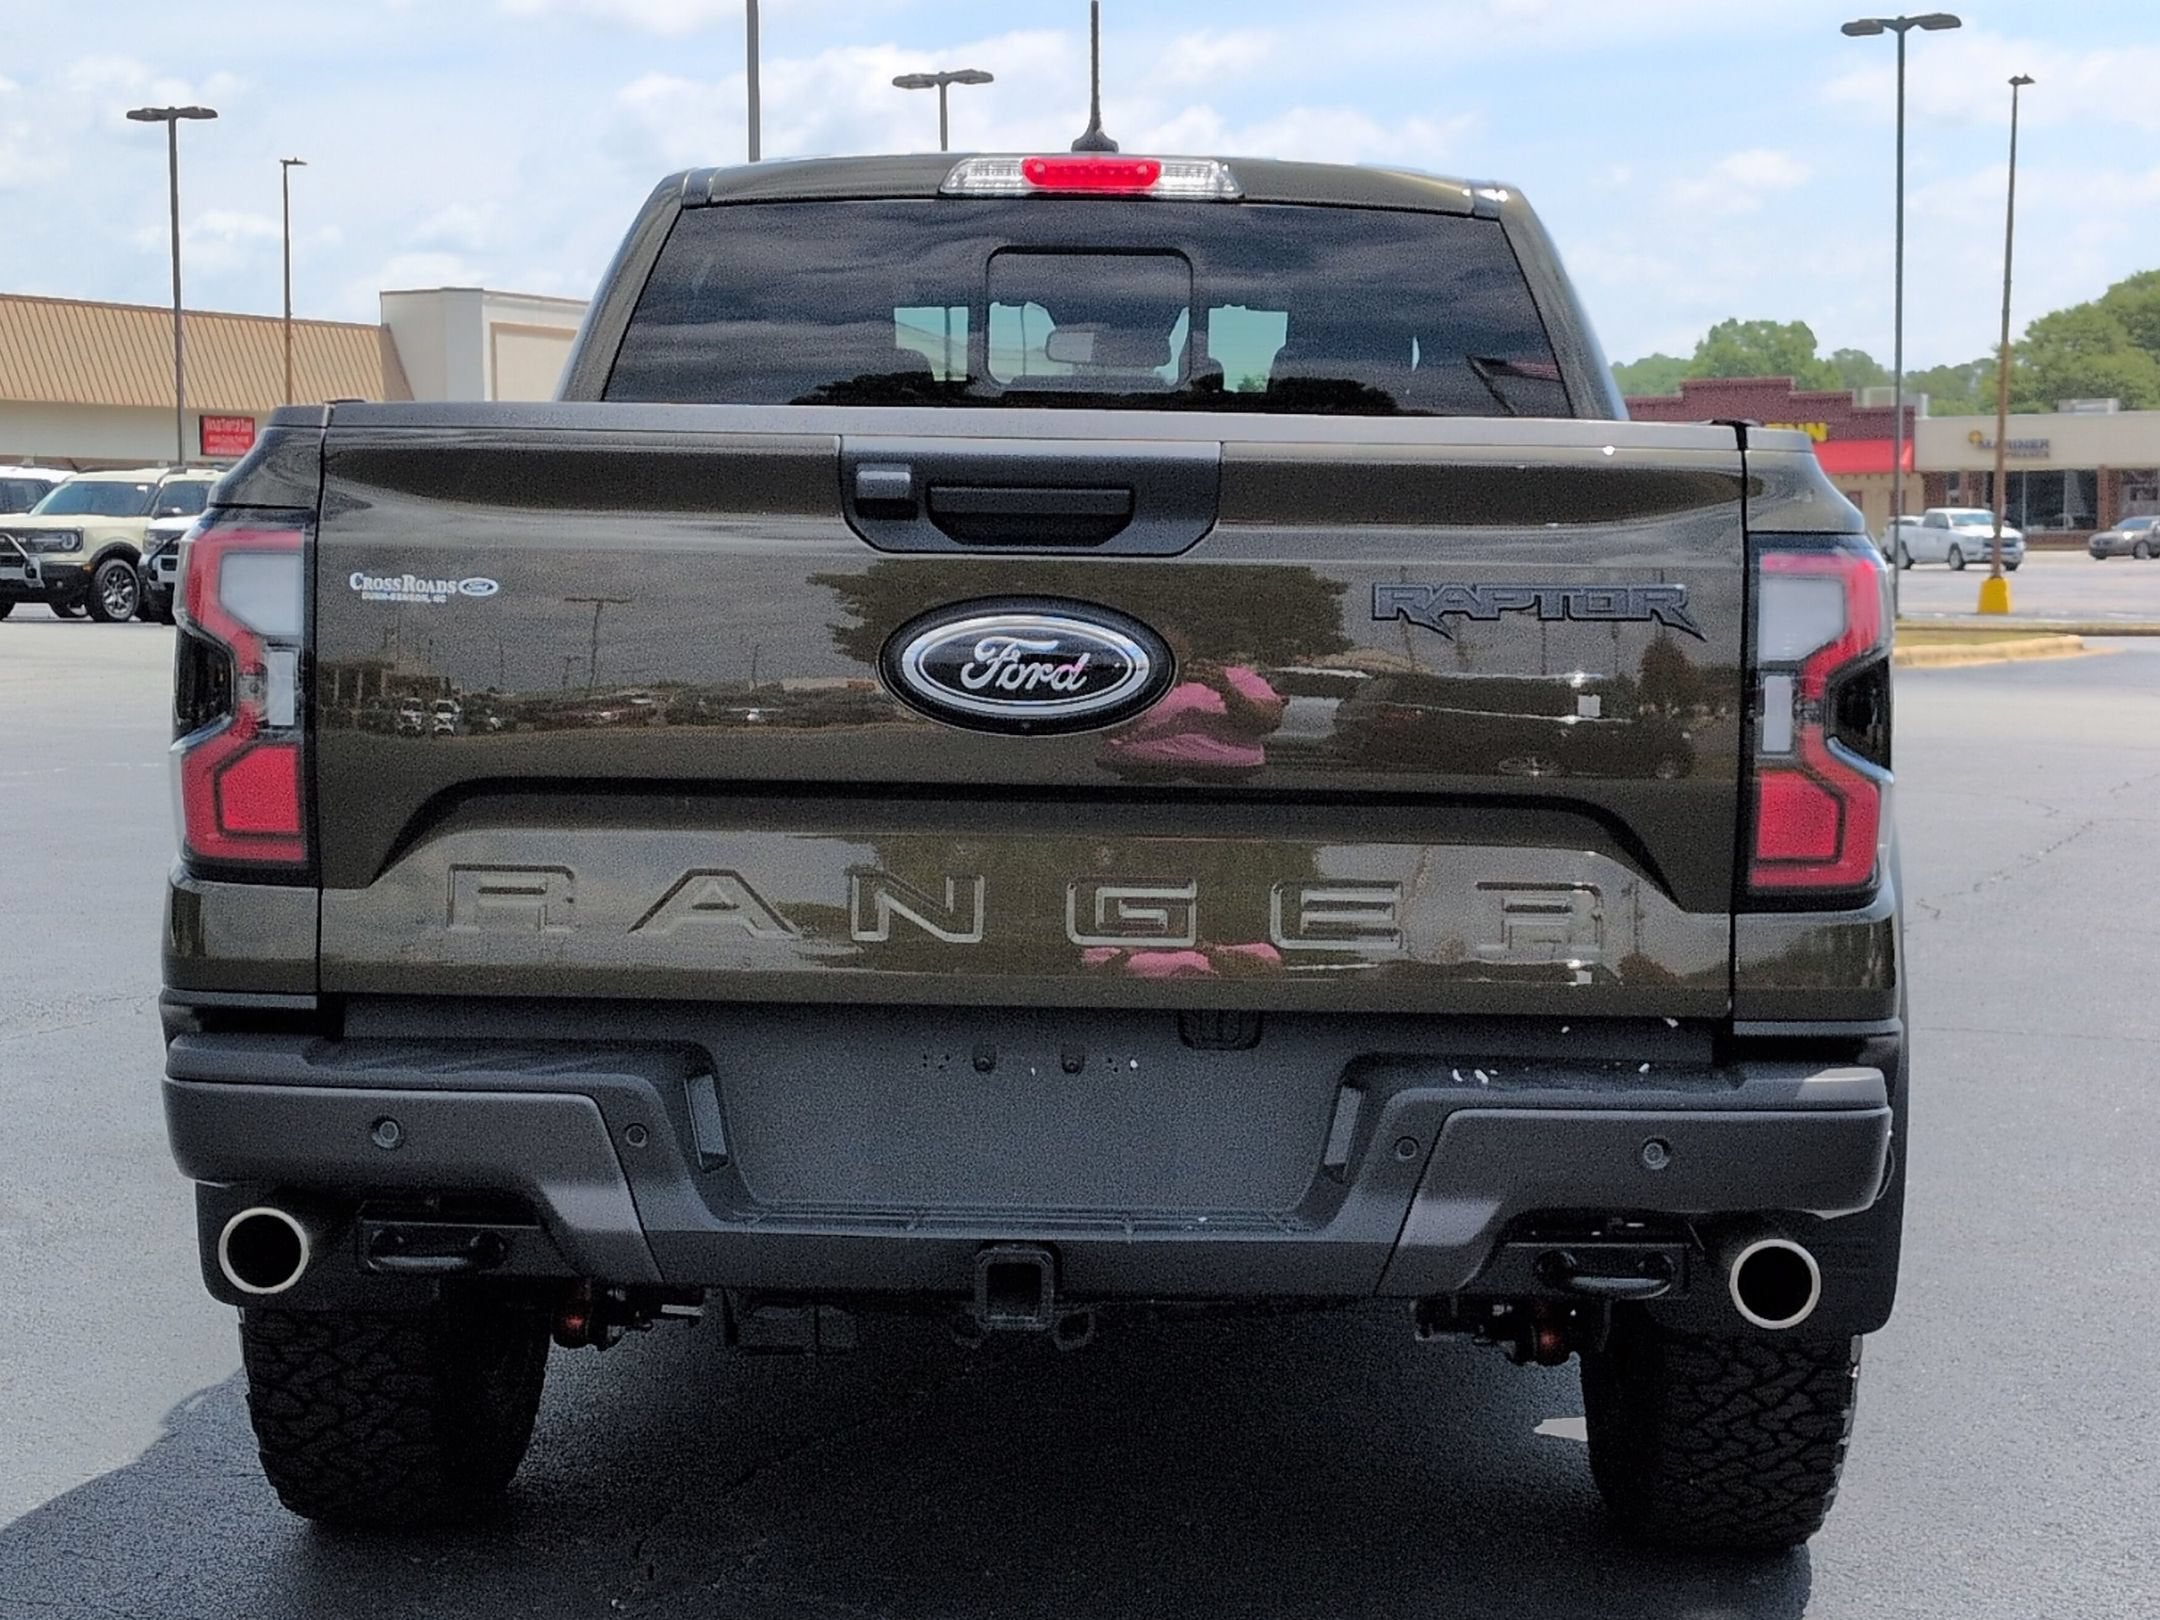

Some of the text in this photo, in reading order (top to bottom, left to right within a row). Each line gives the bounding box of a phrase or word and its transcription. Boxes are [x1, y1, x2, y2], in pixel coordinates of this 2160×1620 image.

[1372, 583, 1706, 641] RAPTOR
[960, 636, 1091, 690] Ford
[447, 863, 1603, 950] RANGER
